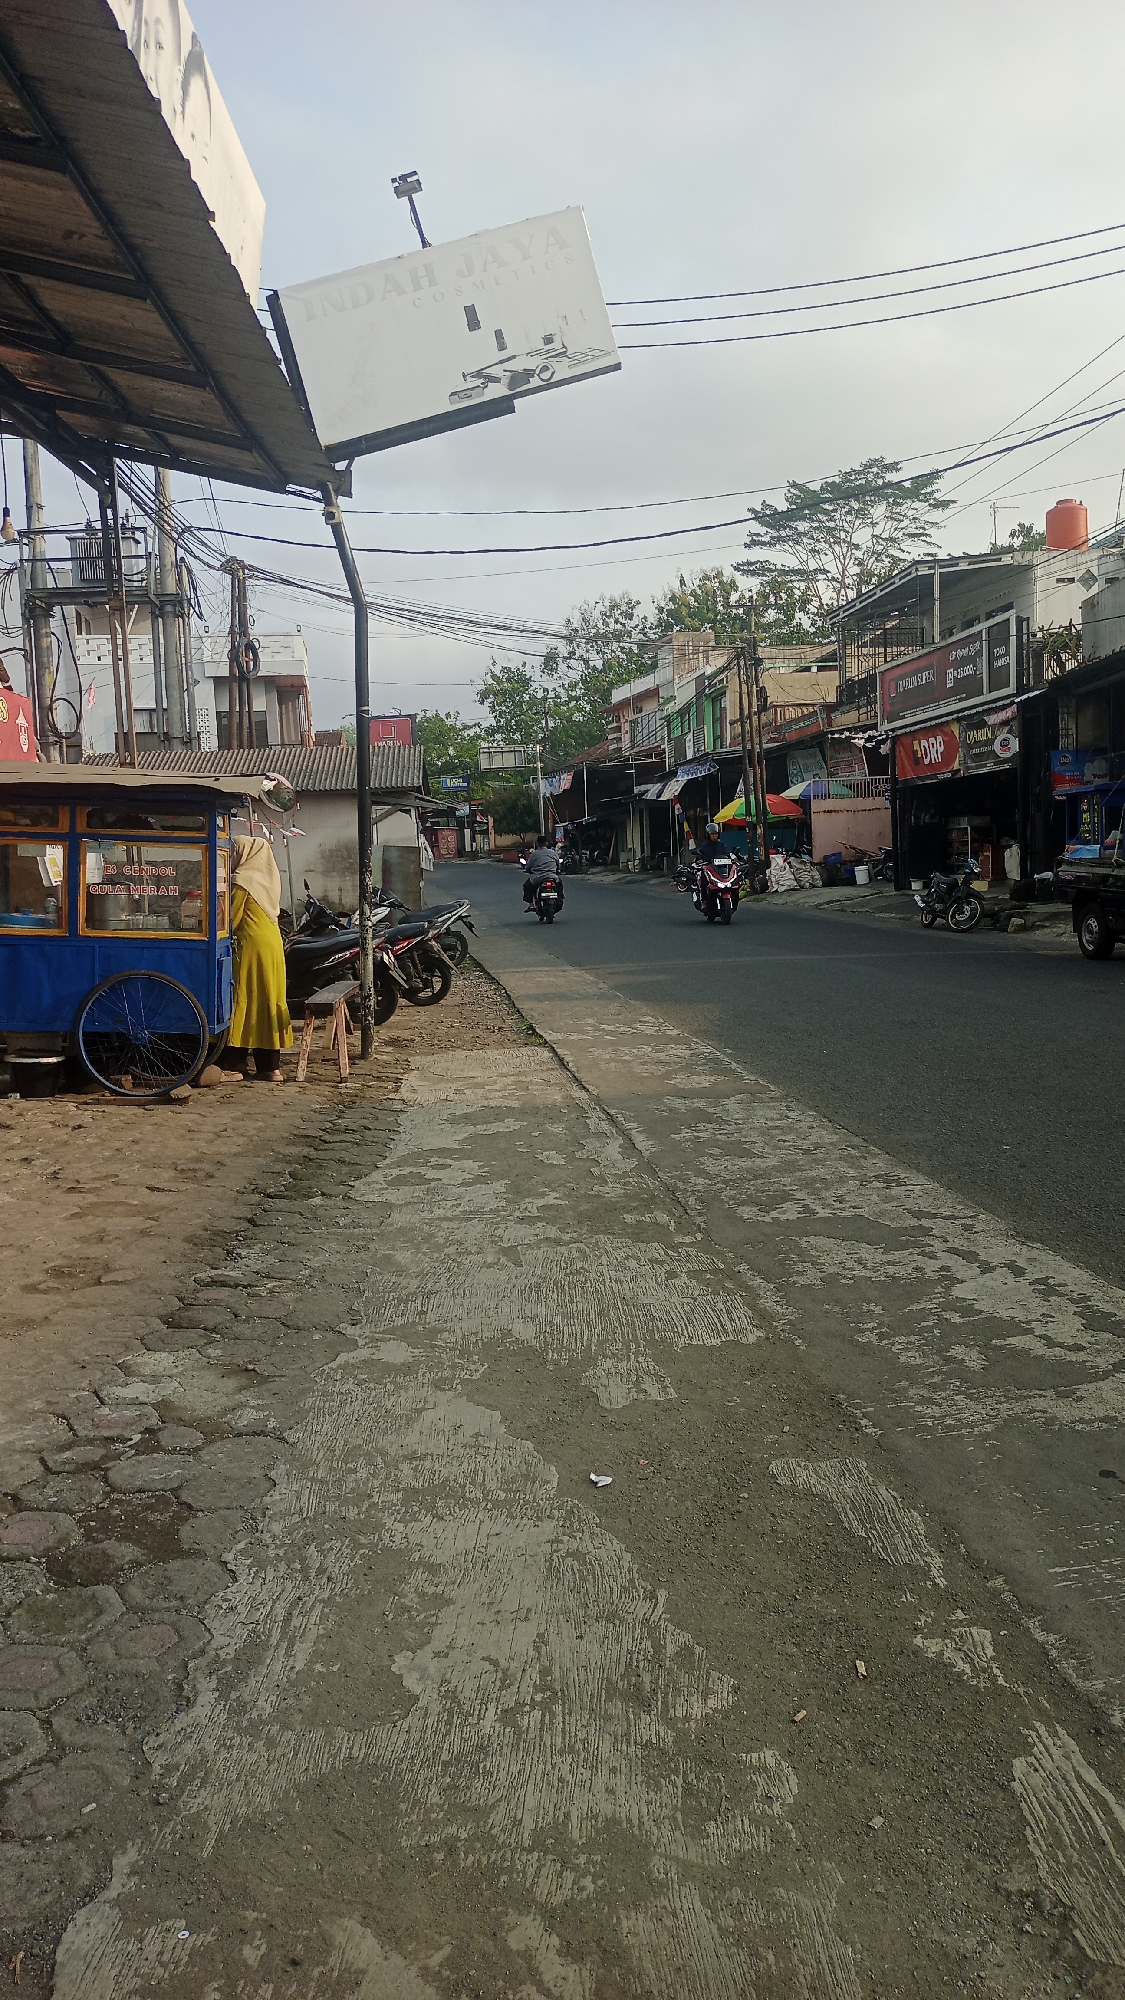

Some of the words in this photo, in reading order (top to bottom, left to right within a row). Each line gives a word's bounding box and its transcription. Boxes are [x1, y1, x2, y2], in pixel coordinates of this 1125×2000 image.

[303, 263, 439, 322] INDAH
[455, 225, 572, 279] JAYA
[412, 253, 575, 309] COSMETICS
[104, 864, 117, 875] ES
[123, 865, 176, 877] CENDOL
[89, 885, 124, 895] GULA
[130, 885, 179, 896] MERAH
